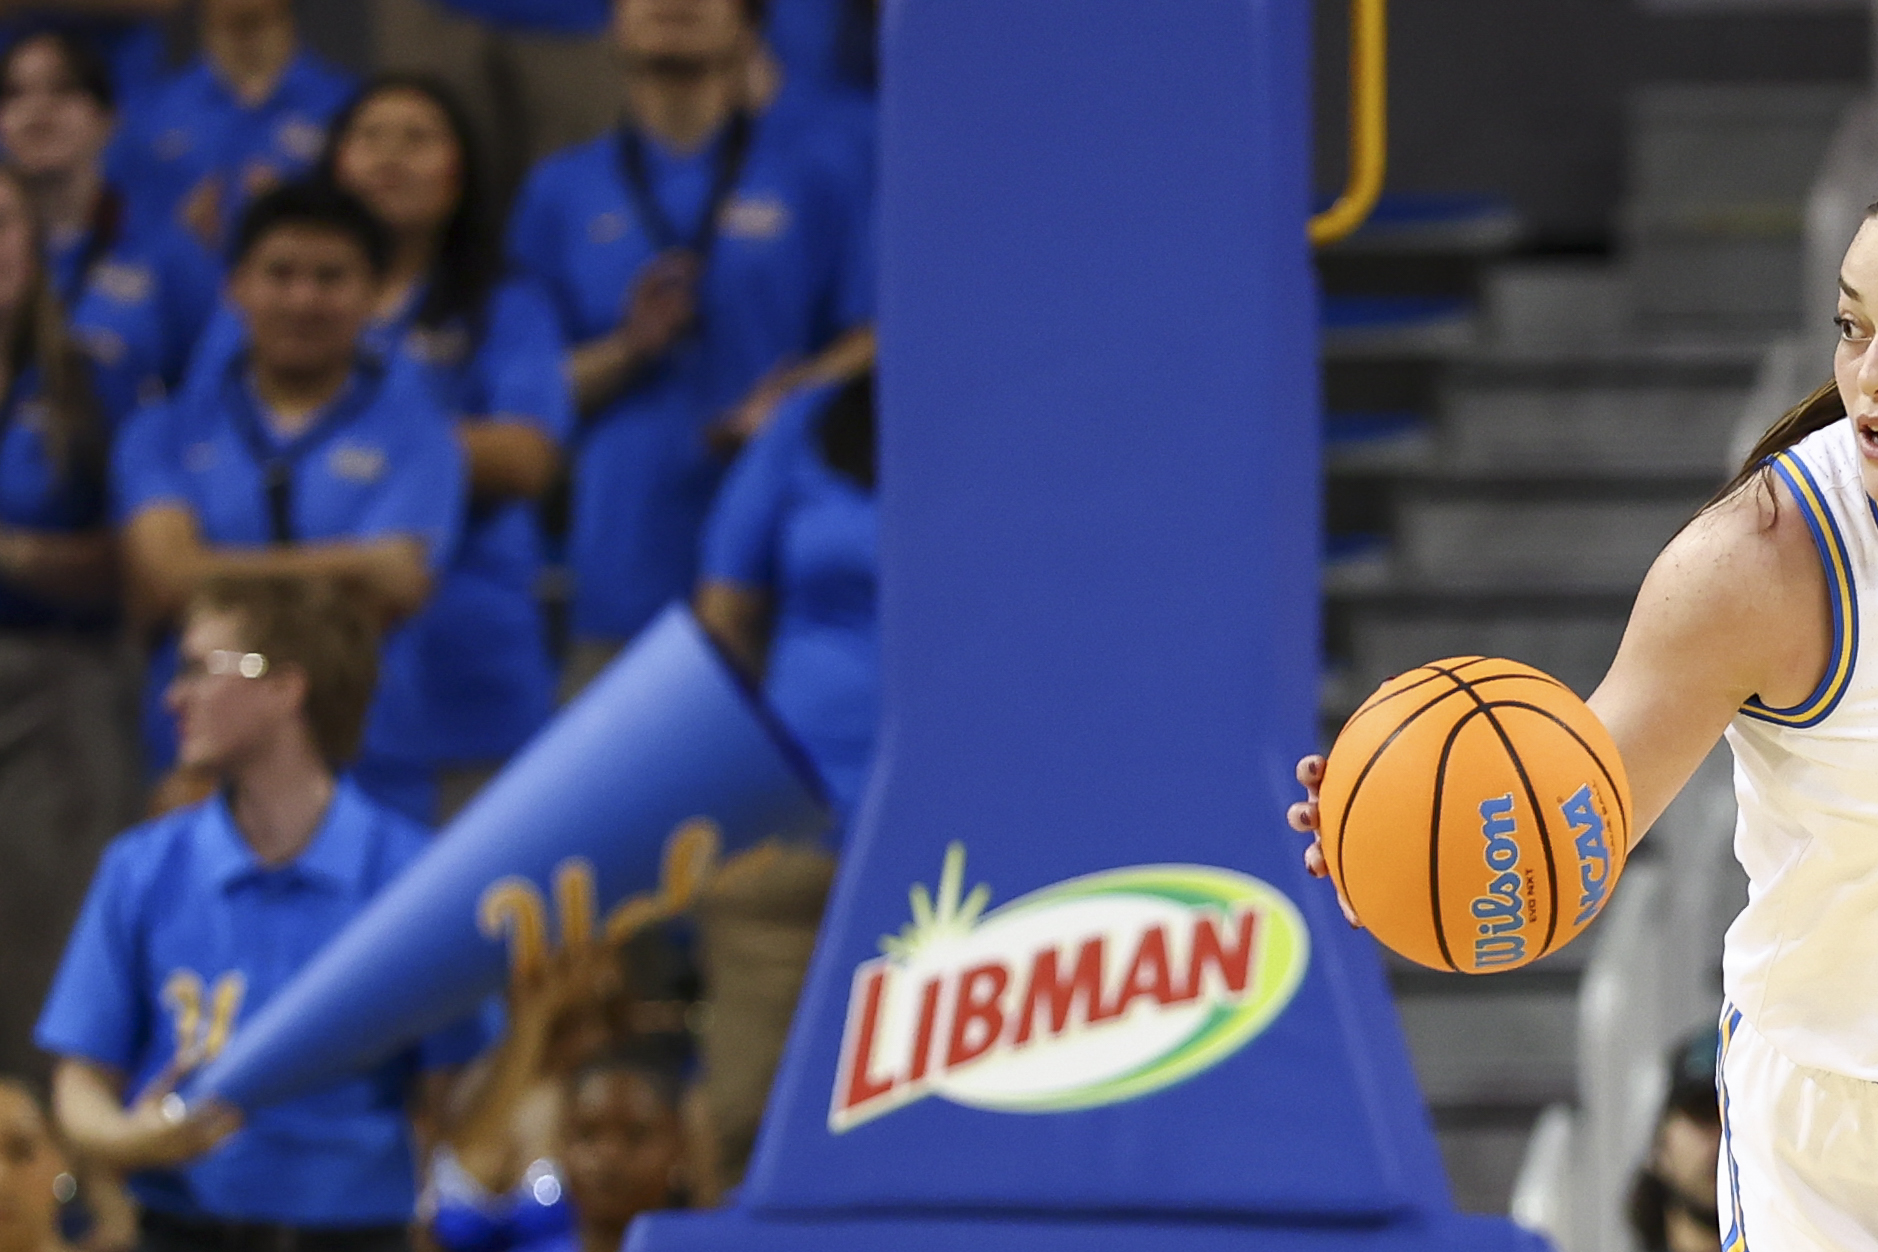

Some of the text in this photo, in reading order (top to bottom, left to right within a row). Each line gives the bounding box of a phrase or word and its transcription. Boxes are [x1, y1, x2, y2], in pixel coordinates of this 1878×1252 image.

[1469, 791, 1529, 969] Wilson
[1558, 782, 1612, 927] NCAA
[845, 908, 1258, 1108] LIBMAN
